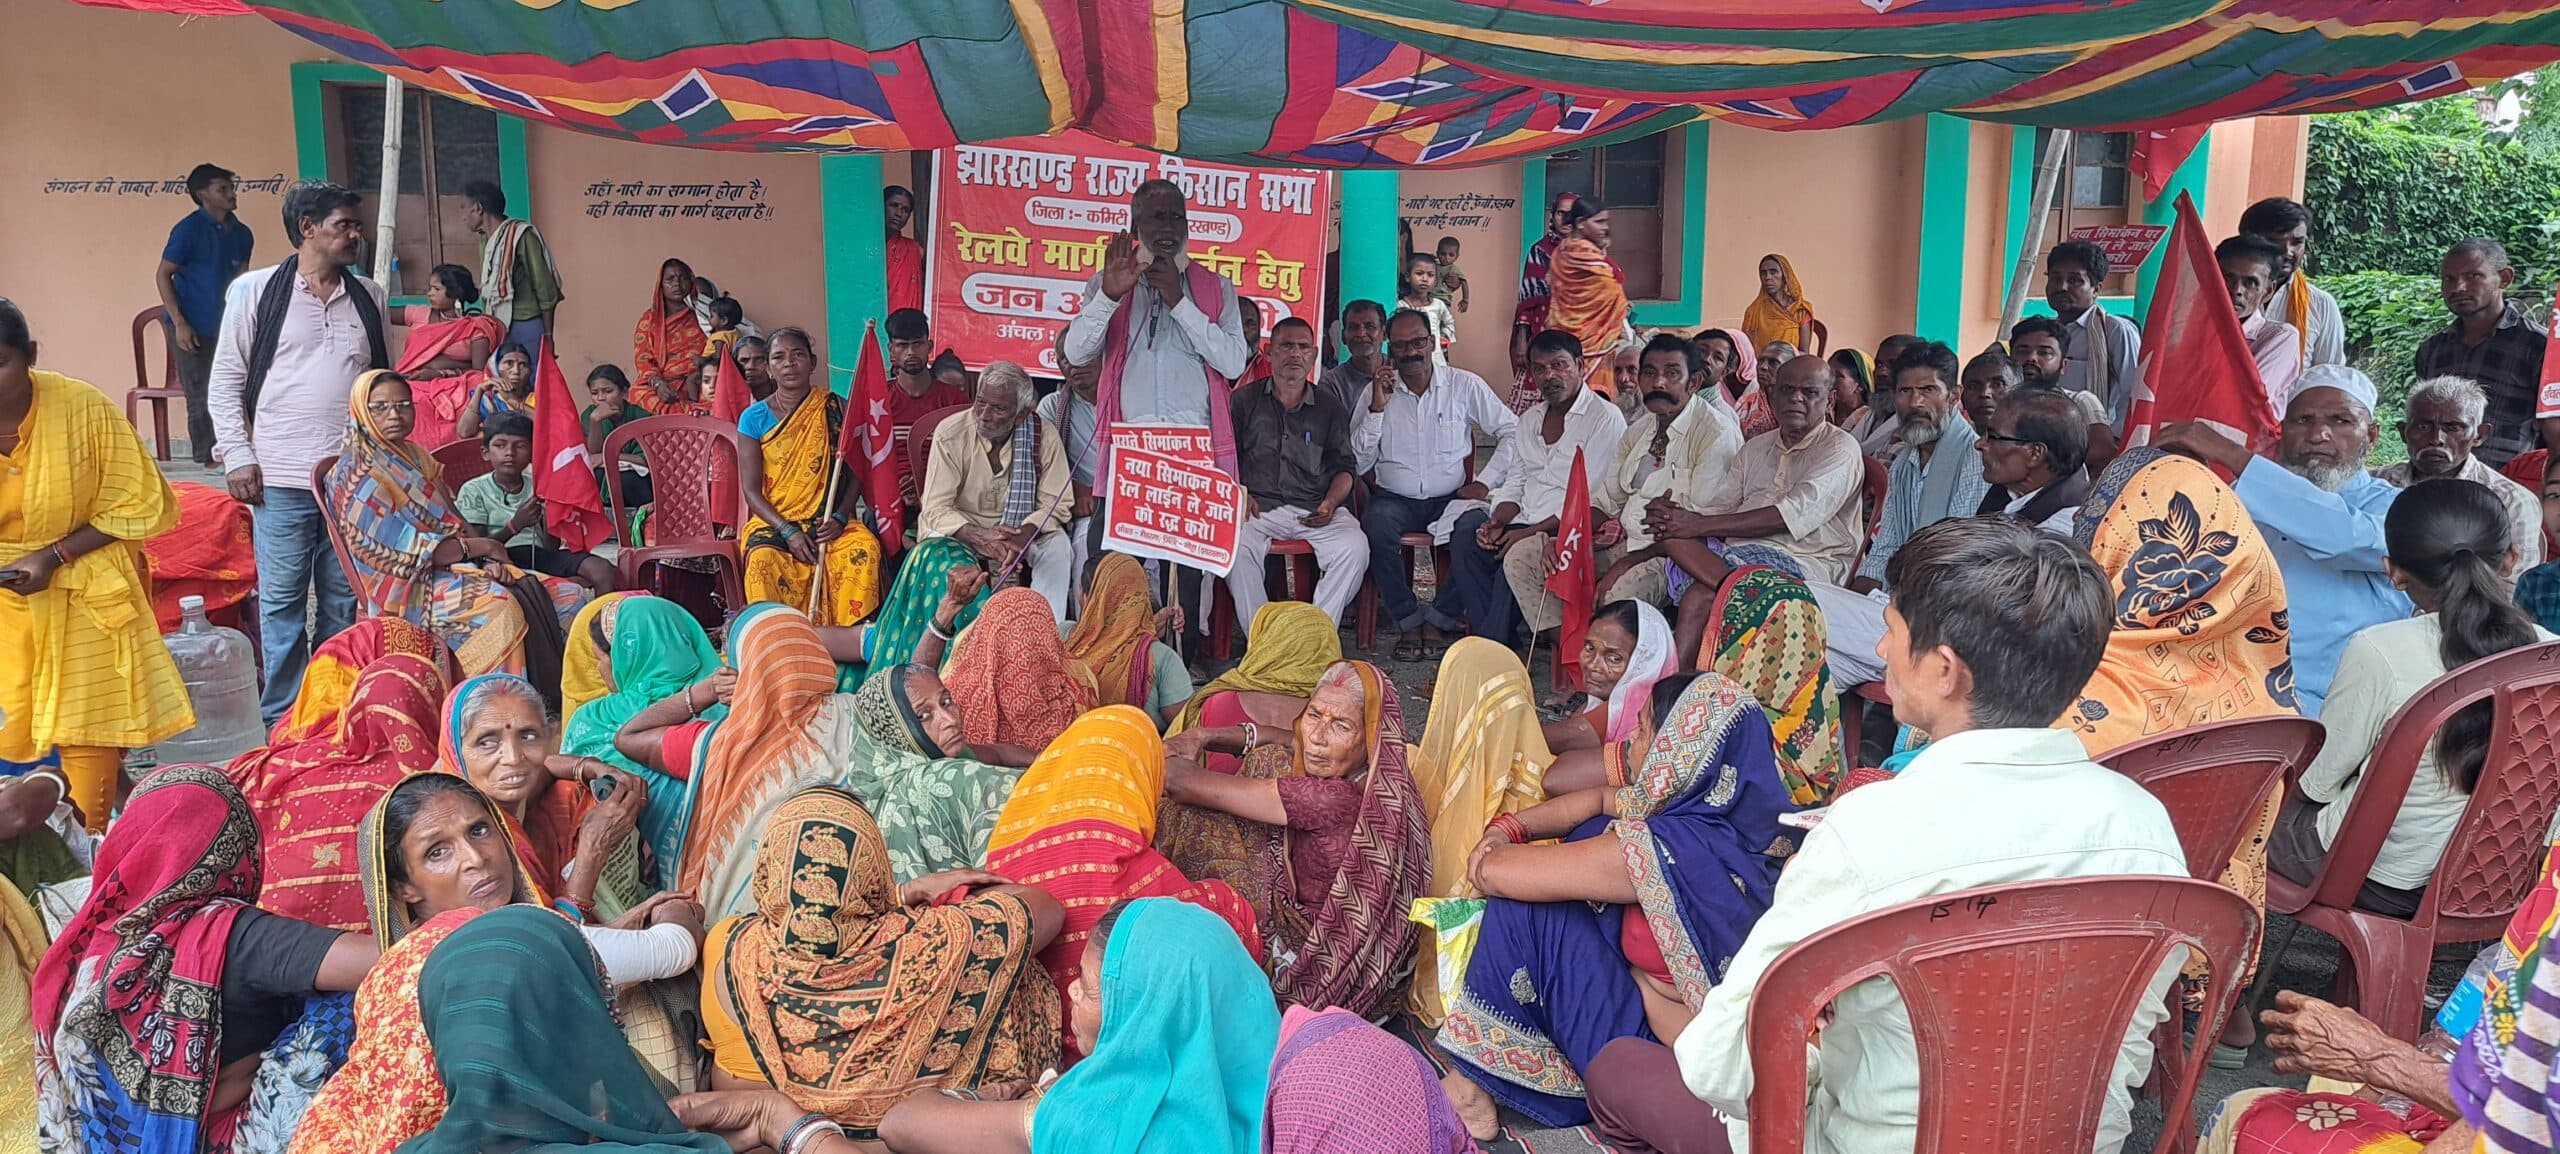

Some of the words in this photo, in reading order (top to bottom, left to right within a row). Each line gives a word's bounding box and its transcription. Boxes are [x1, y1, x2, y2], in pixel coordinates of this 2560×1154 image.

[95, 177, 114, 193] की
[617, 181, 644, 197] नारी
[646, 185, 666, 197] का
[669, 185, 713, 198] सम्मान
[716, 181, 746, 200] होता
[955, 144, 1076, 193] झारखण्ड
[1084, 156, 1150, 196] राज्य
[1158, 153, 1249, 210] किसान
[1259, 173, 1316, 216] सभा
[612, 202, 657, 218] विकास
[659, 205, 681, 217] का
[712, 206, 754, 221] खुलता
[1032, 201, 1065, 219] जिला
[1086, 207, 1128, 226] कमिटी
[1188, 218, 1231, 240] रखण्ड)
[951, 222, 1031, 267] रेलवे
[1041, 234, 1109, 272] मार्ग
[1256, 249, 1305, 302] हेतु
[975, 283, 1047, 312] जन
[996, 320, 1045, 341] अंचल
[1195, 436, 1213, 452] पर
[1124, 457, 1153, 478] नया
[1156, 459, 1212, 494] सिमांकन
[1215, 479, 1234, 500] पर
[1117, 473, 1141, 499] रेल
[1145, 485, 1184, 509] लाईन
[1186, 491, 1202, 515] ले
[1205, 500, 1235, 524] जाने
[1134, 503, 1154, 525] को
[1184, 517, 1215, 542] करो।
